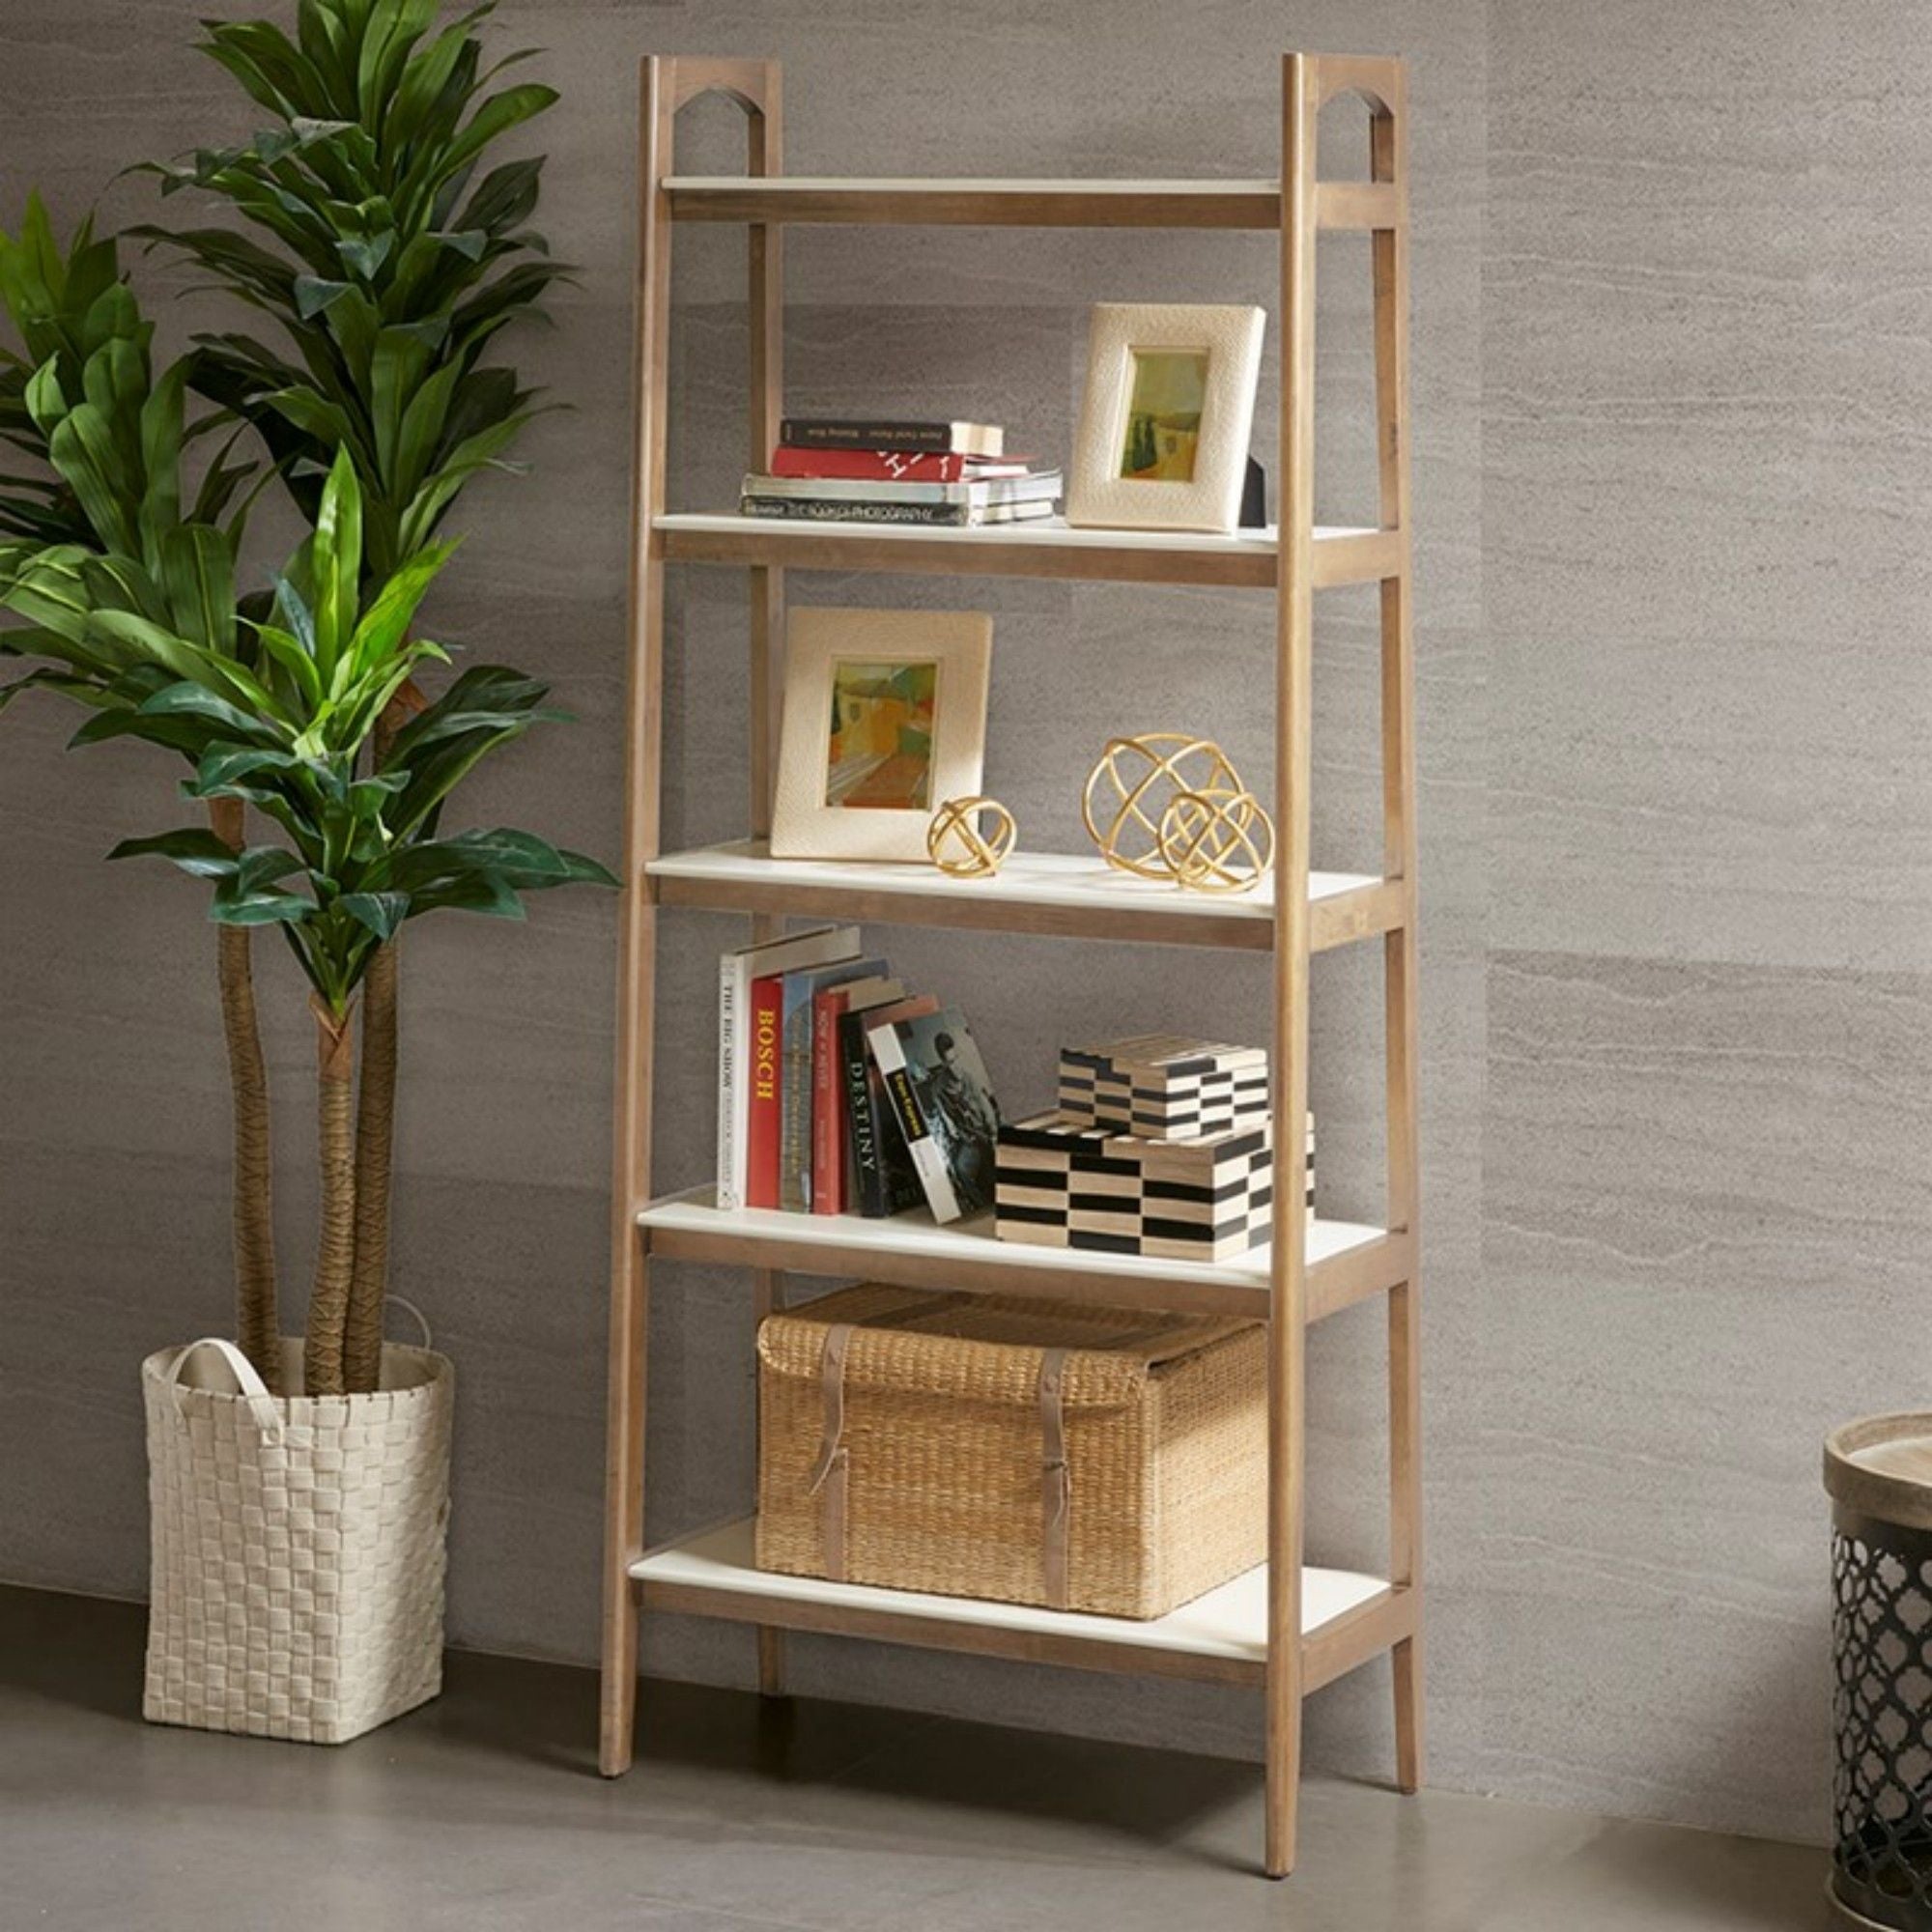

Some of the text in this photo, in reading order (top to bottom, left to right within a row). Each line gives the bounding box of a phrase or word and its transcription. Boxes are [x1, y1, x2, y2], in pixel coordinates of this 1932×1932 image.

[723, 985, 733, 1011] THE
[723, 1018, 733, 1044] BIG
[723, 1048, 733, 1089] SHOW
[756, 1009, 775, 1099] BOSCH
[850, 1062, 875, 1171] DESTINY
